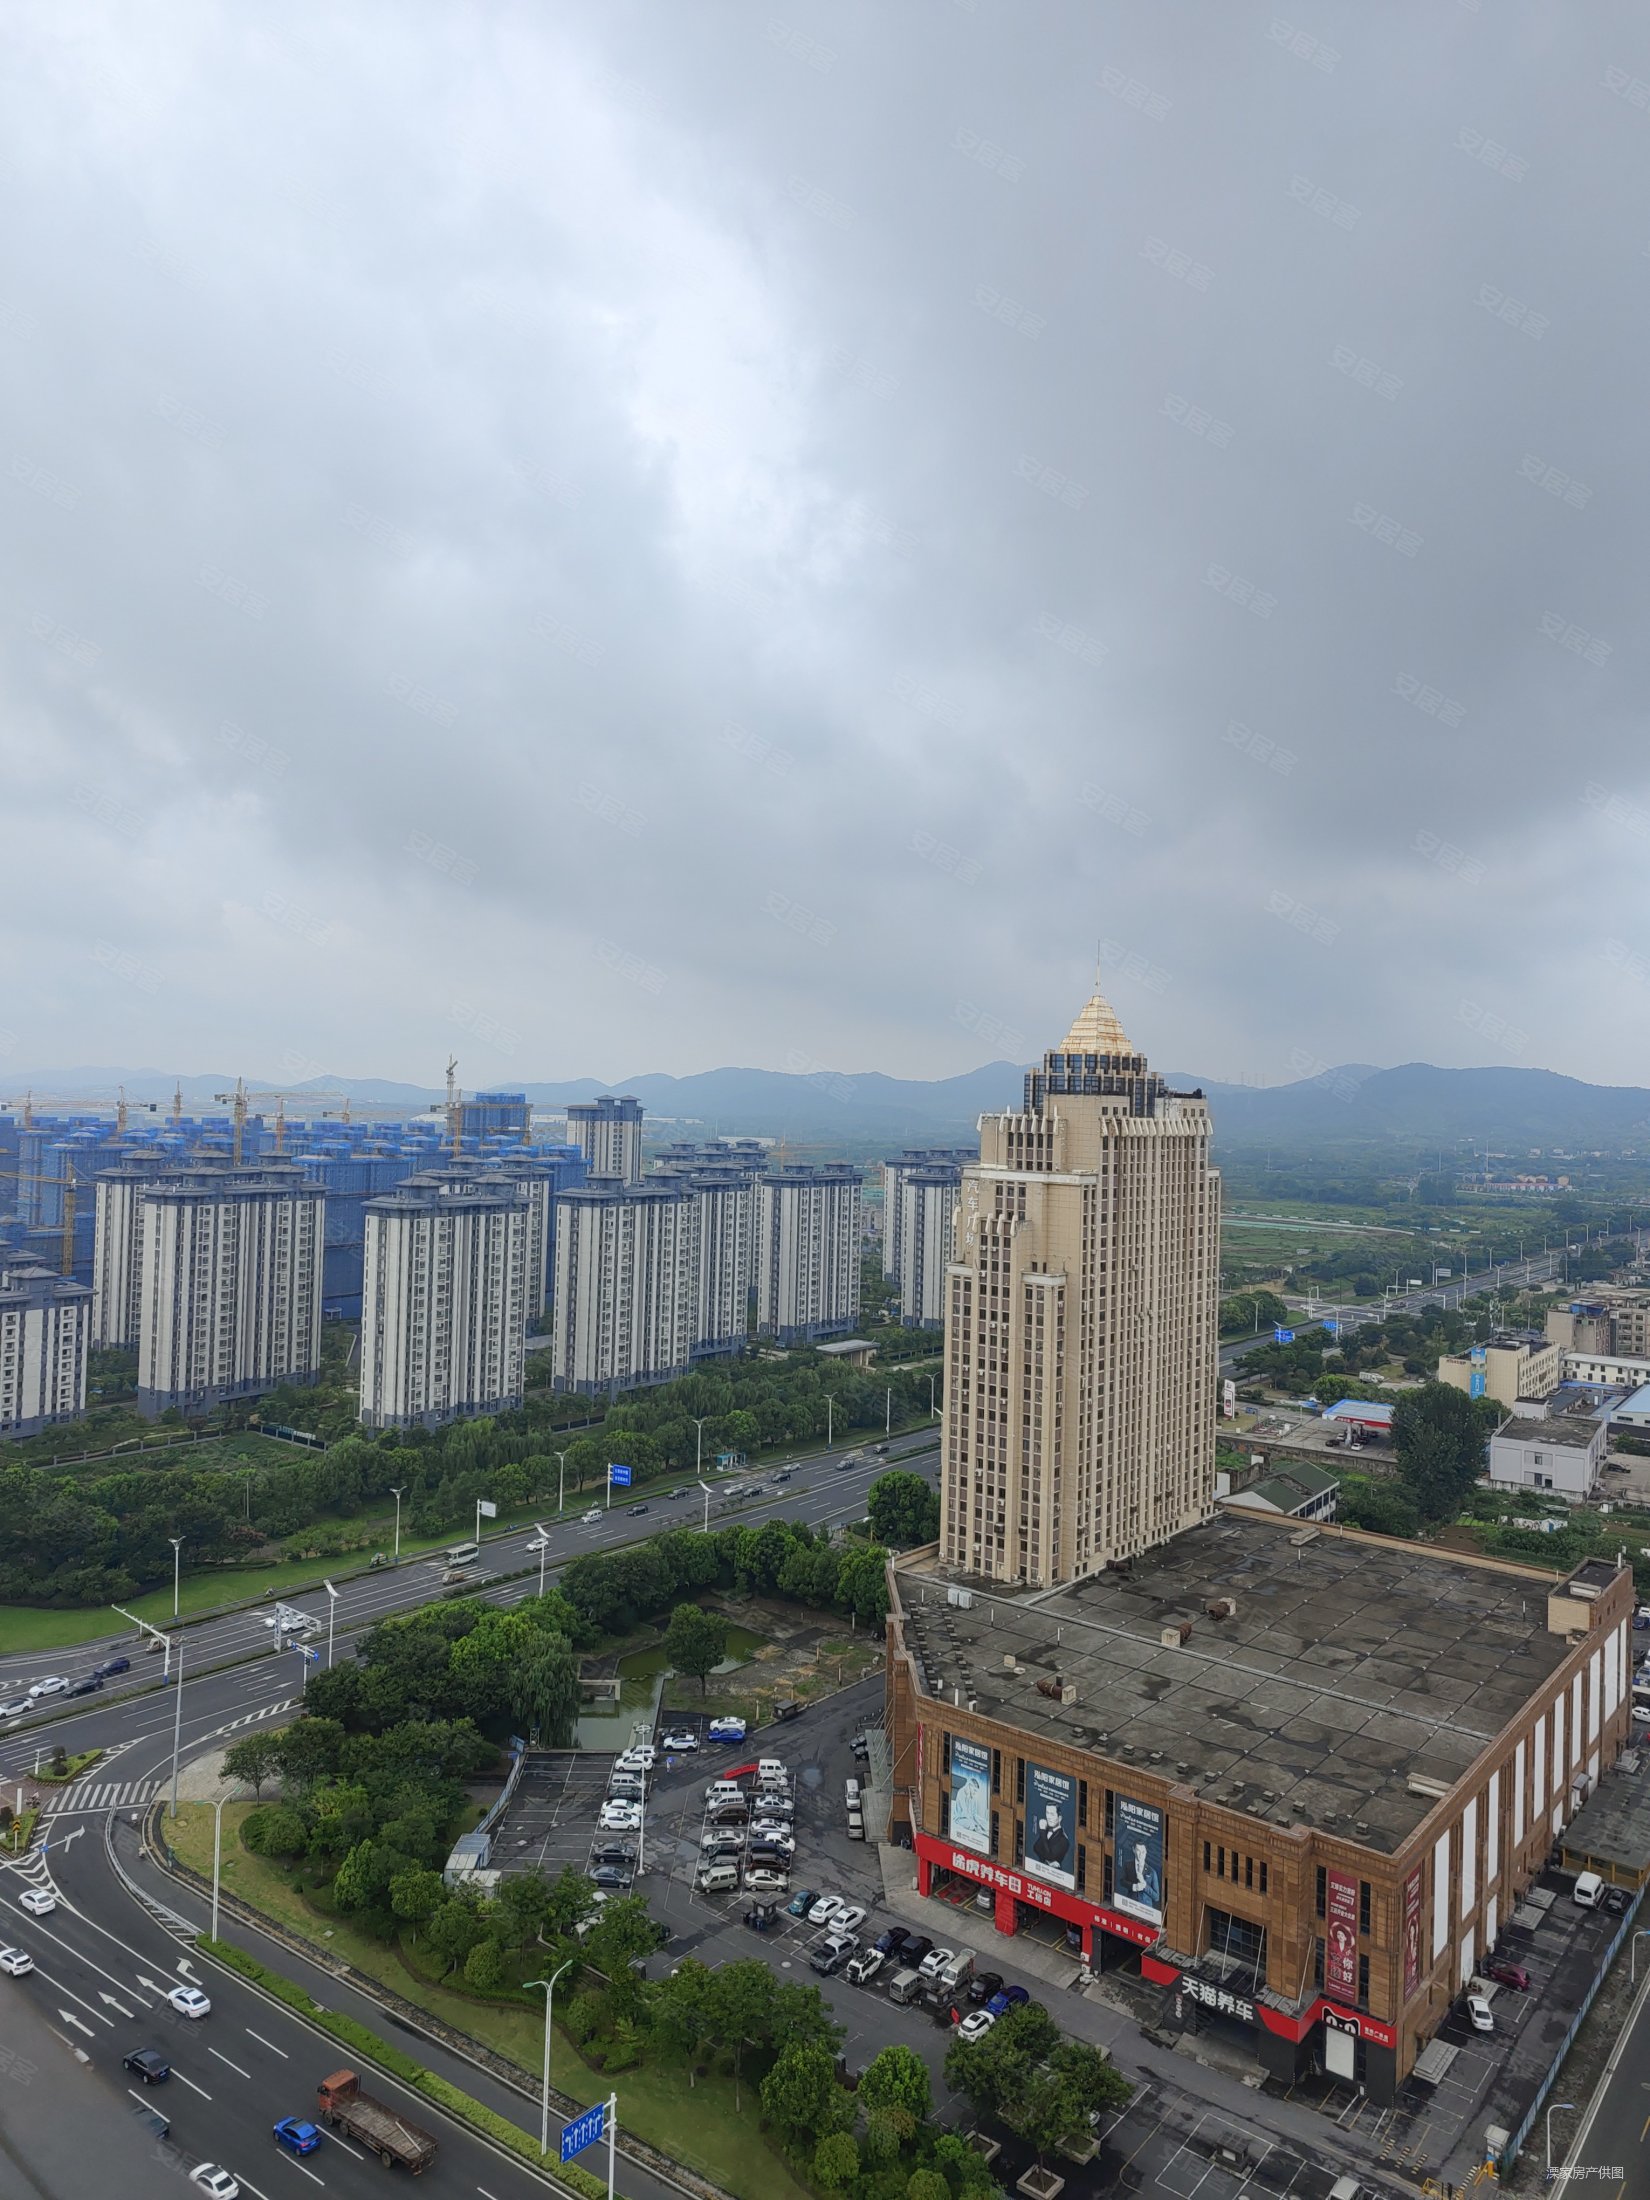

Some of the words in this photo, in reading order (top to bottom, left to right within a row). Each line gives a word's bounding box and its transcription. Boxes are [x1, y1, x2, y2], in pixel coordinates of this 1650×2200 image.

[952, 1852, 1008, 1888] 途虎养车
[1342, 1957, 1354, 1983] 你好
[1182, 1975, 1254, 2021] 天猫养车
